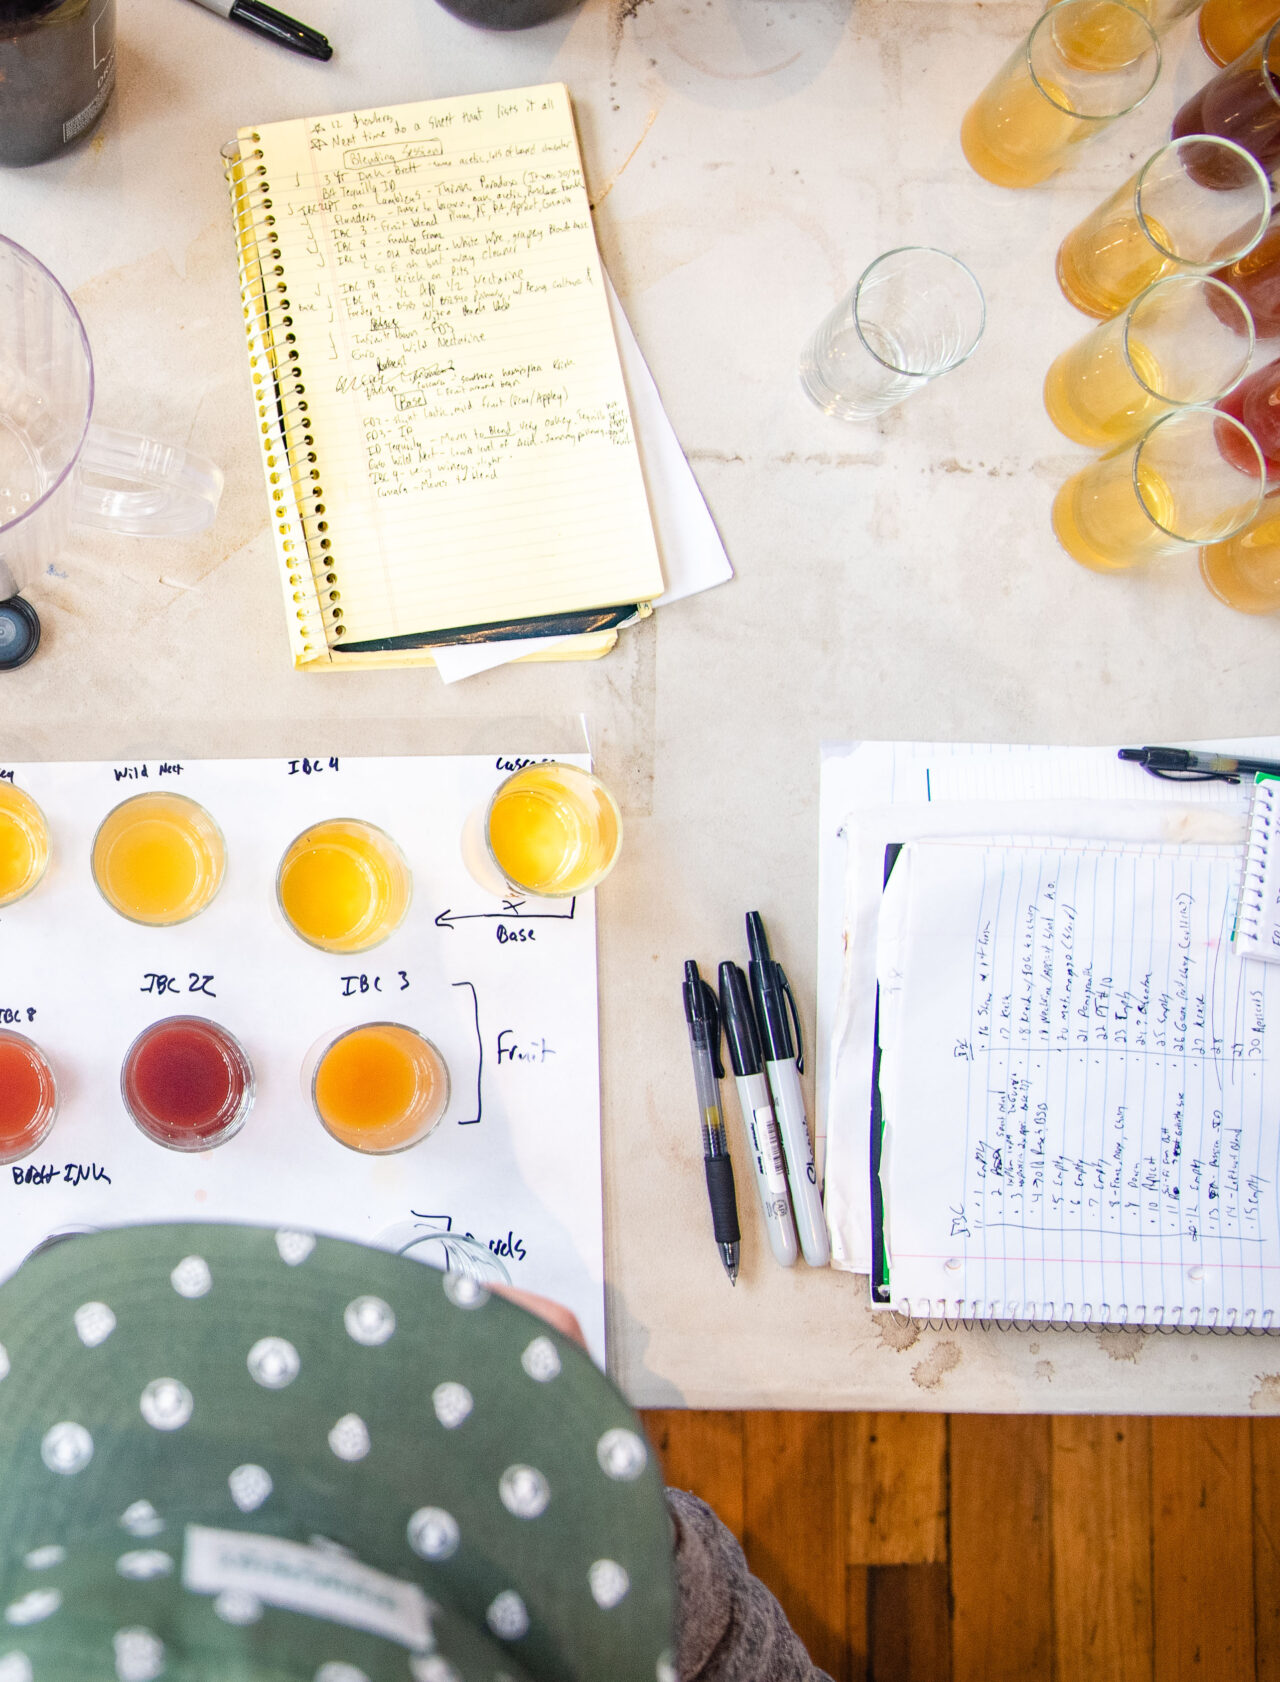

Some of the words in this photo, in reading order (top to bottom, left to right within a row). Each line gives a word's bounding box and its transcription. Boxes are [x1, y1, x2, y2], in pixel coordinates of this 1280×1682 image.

[393, 119, 407, 134] do
[114, 764, 148, 781] Wild
[288, 758, 324, 775] IBC
[327, 756, 340, 772] 4
[496, 924, 536, 943] Base
[140, 973, 180, 994] IBC
[341, 975, 382, 996] IBC
[397, 971, 411, 991] 3
[25, 1007, 37, 1022] 8
[496, 1030, 558, 1065] Fruit
[63, 1162, 111, 1186] INK
